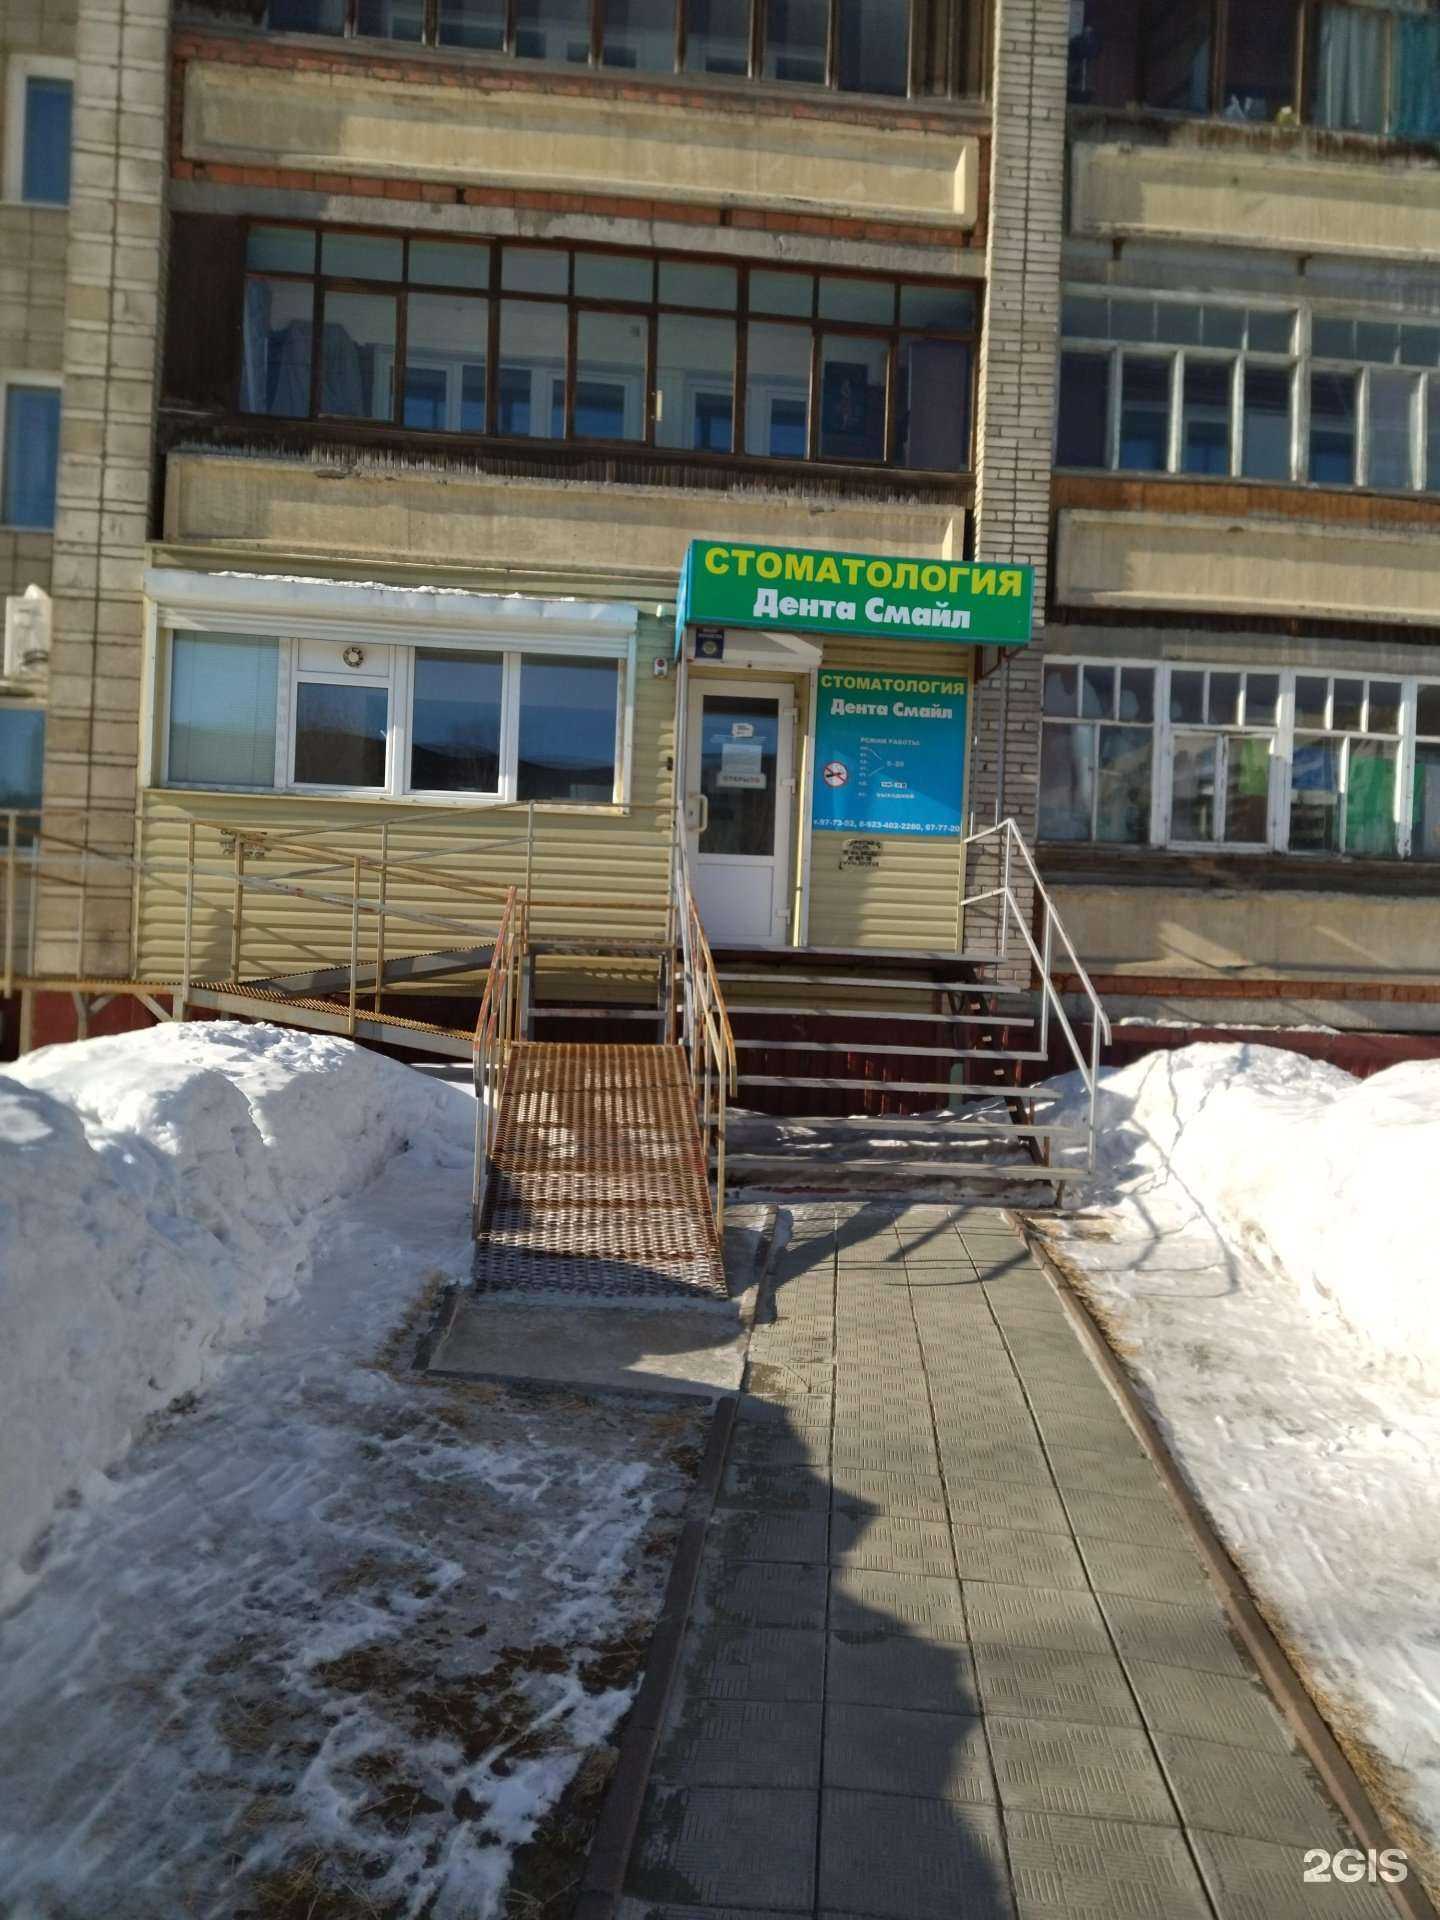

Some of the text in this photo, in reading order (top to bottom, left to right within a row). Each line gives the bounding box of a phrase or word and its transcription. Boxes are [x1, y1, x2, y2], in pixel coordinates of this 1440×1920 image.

[704, 547, 1023, 597] СТОМАТОЛОГИЯ
[753, 588, 971, 629] Дента Смайл
[821, 675, 965, 695] СТОМАТОЛОГИЯ
[830, 698, 953, 719] Дента Смайл
